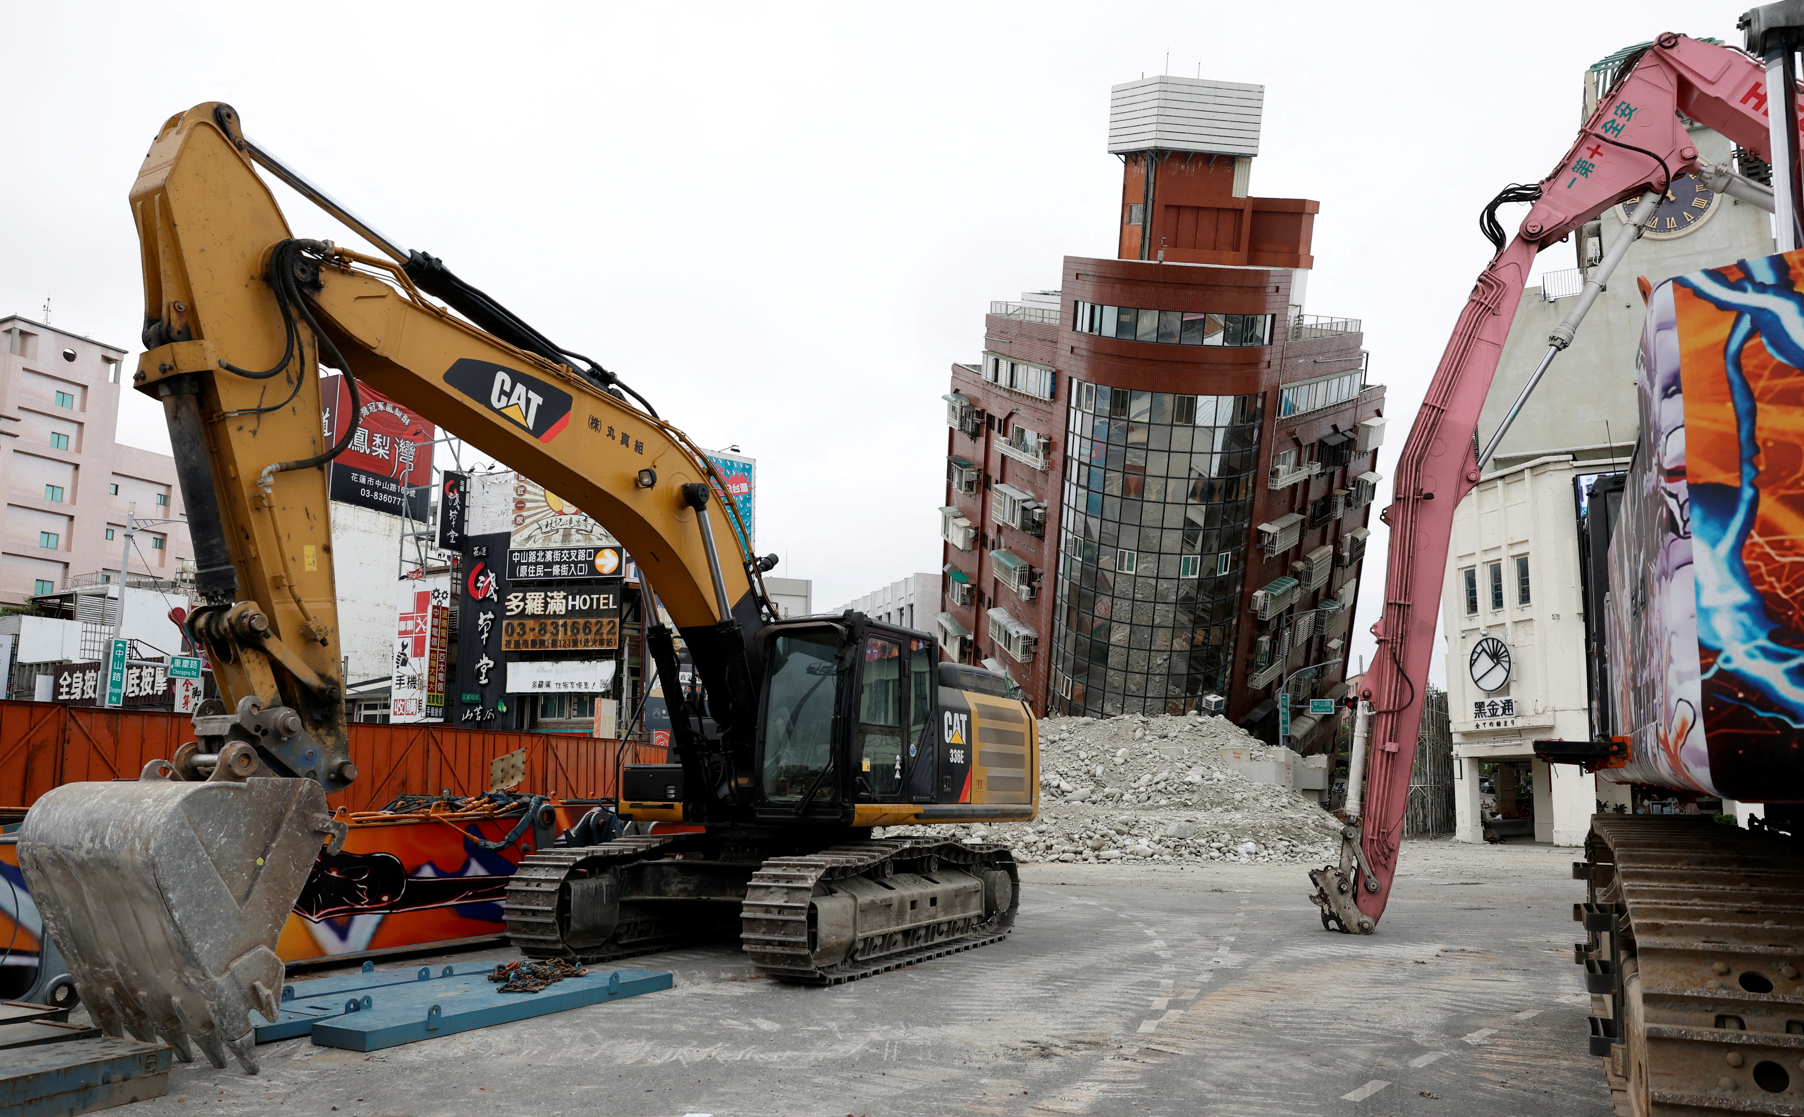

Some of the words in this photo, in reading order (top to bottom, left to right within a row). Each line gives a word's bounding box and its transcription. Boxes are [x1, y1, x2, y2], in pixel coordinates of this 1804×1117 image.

[1601, 101, 1638, 138] 安全
[490, 371, 544, 431] CAT
[512, 549, 594, 563] 中山路北濱街交叉路口
[516, 563, 588, 577] (原住民一條街入口)
[504, 620, 617, 637] 03-8316622
[112, 649, 124, 682] 中山路
[174, 658, 198, 669] 重慶路
[1474, 699, 1514, 719] 黑金通
[944, 711, 967, 745] CAT
[950, 749, 964, 764] 336E
